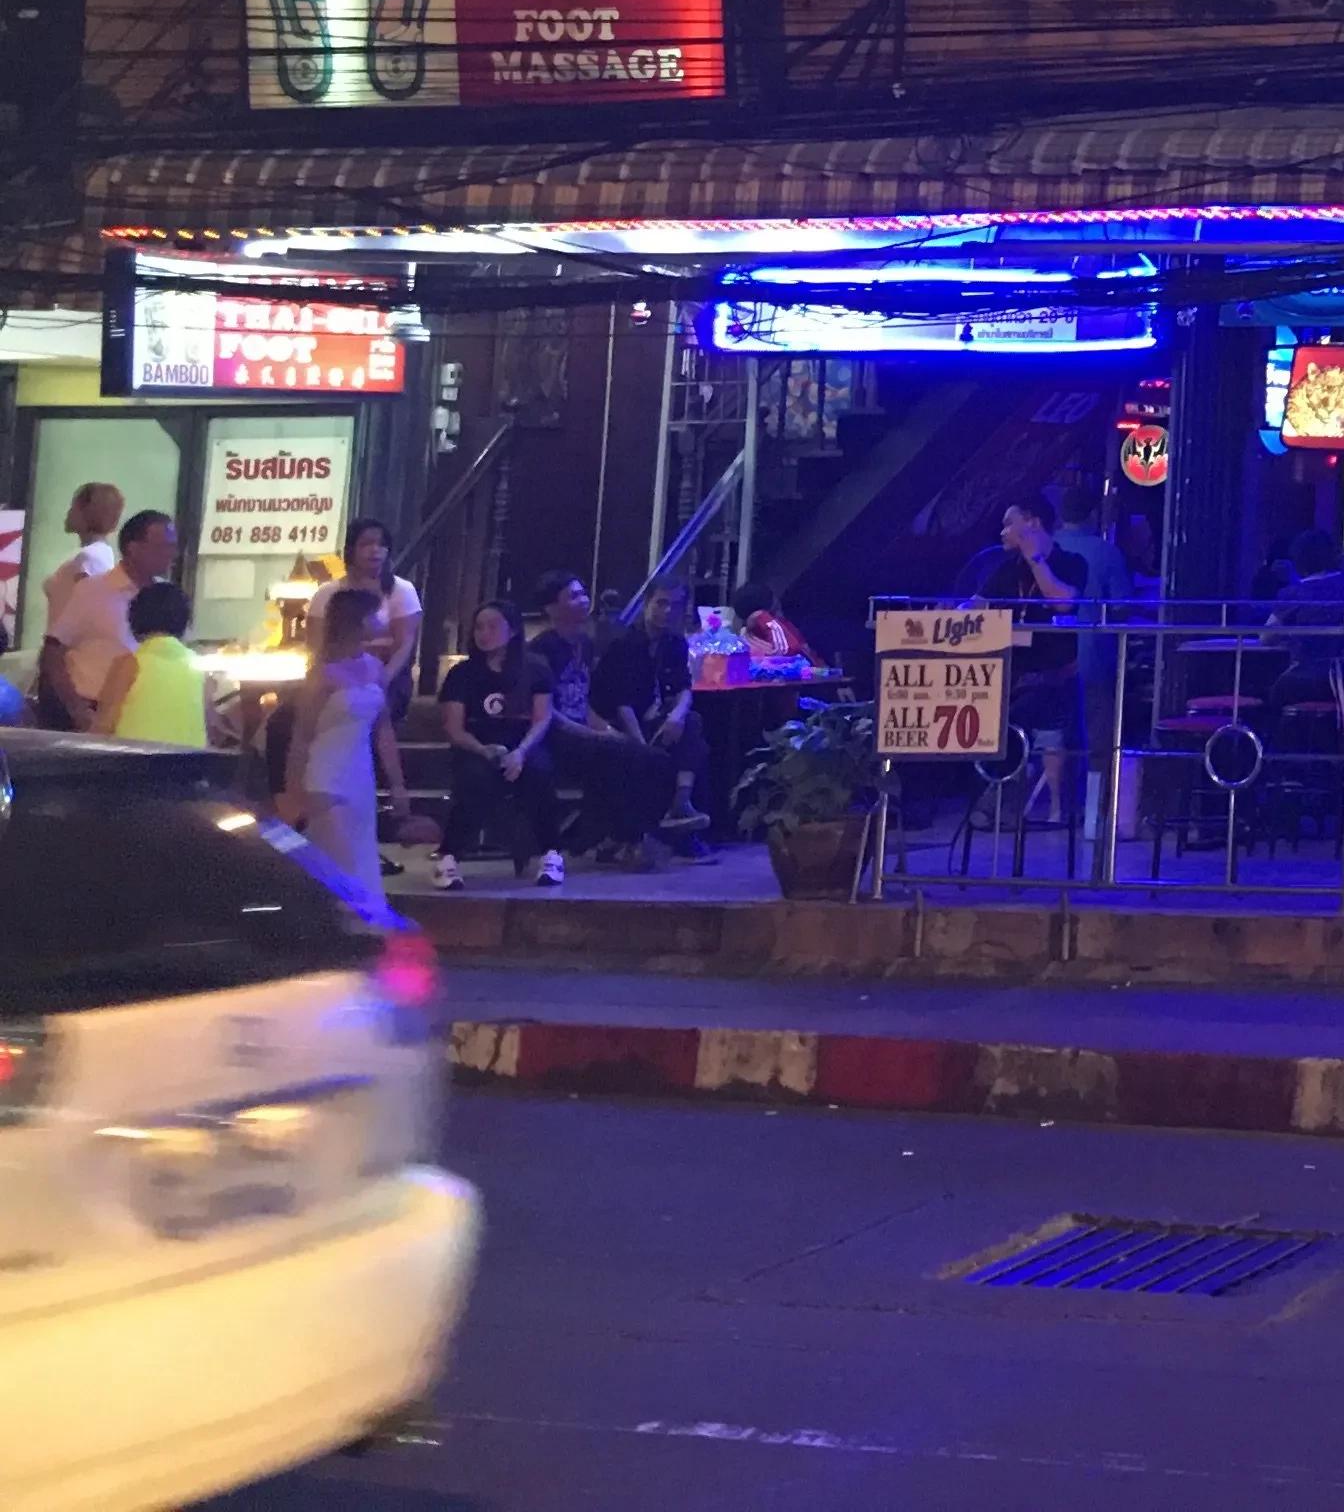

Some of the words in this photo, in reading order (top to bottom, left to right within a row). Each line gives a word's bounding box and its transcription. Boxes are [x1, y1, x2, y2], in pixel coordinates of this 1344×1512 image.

[513, 7, 619, 42] FOOT
[491, 47, 685, 84] MASSAGE
[219, 332, 317, 364] FOOT
[143, 363, 210, 385] BAMBOO
[225, 450, 332, 480] รับสมัคร
[211, 526, 242, 544] 081
[250, 526, 282, 543] 858
[288, 525, 329, 543] 4119
[932, 612, 986, 647] Light
[885, 664, 933, 688] ALL
[944, 663, 996, 687] DAY
[884, 706, 931, 729] ALL
[933, 704, 980, 750] 70
[884, 730, 929, 748] BEER
